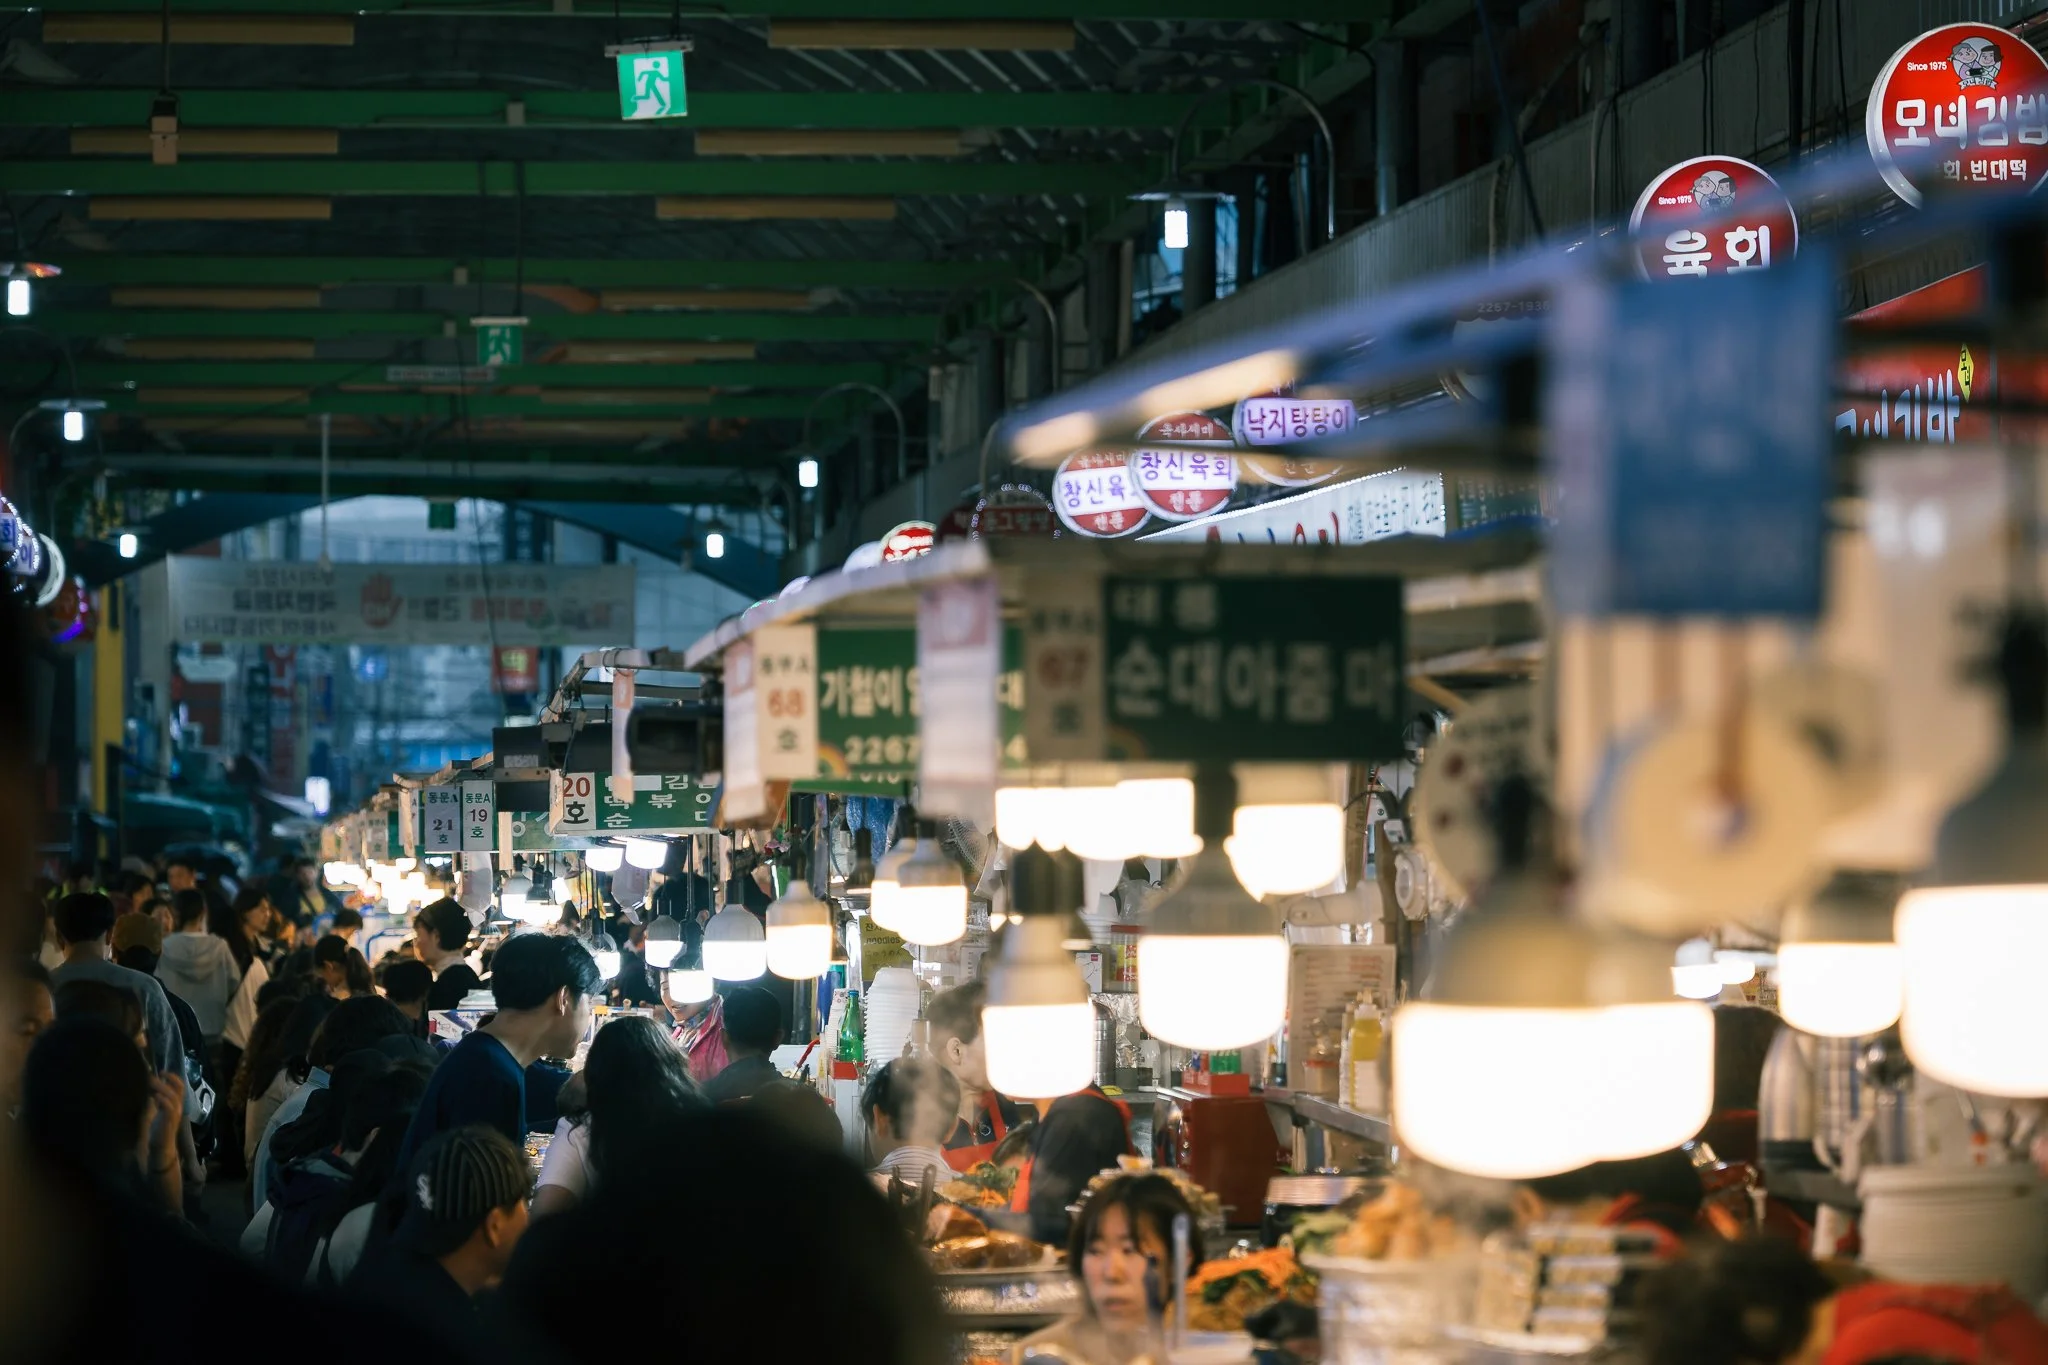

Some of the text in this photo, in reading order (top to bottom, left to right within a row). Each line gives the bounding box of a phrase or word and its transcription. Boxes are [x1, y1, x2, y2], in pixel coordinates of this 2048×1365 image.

[1907, 61, 1947, 71] Since 1975
[1937, 159, 2027, 183] 회.빈대떡
[1658, 195, 1692, 205] Since 1975
[1141, 452, 1232, 481] 창신육회
[1064, 474, 1139, 508] 창신육
[563, 777, 591, 797] 20
[465, 793, 491, 804] 동문A
[470, 809, 488, 822] 19
[563, 801, 589, 824] 호
[471, 826, 485, 838] 호
[438, 834, 449, 844] 호
